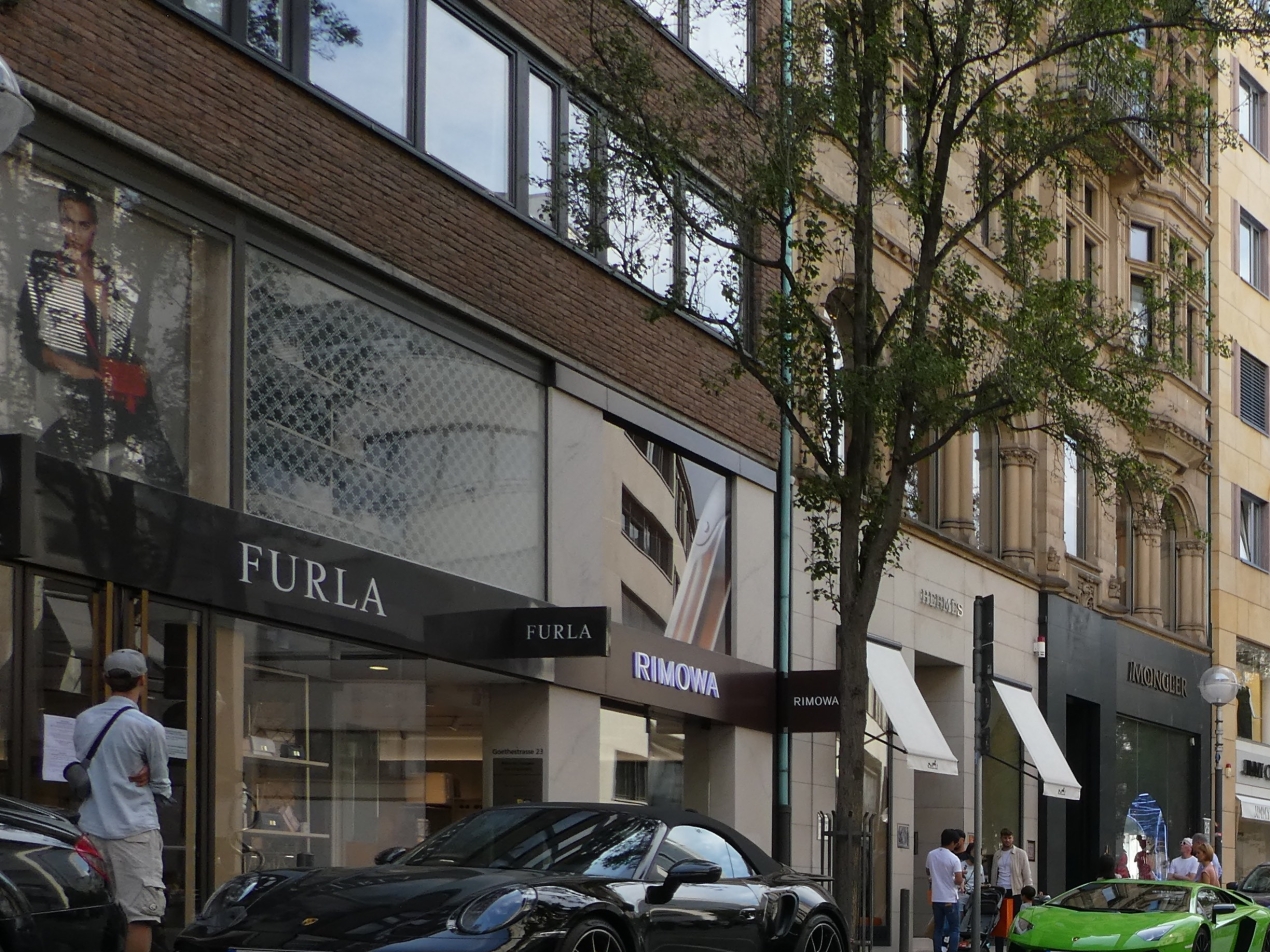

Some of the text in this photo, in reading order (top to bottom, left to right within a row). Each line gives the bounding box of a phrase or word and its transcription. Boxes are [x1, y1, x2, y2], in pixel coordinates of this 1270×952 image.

[238, 541, 388, 618] FURLA
[526, 623, 593, 640] FURLA
[632, 651, 720, 699] RIMOWA
[1127, 661, 1188, 698] MONCLER
[793, 696, 840, 707] RIMOWA
